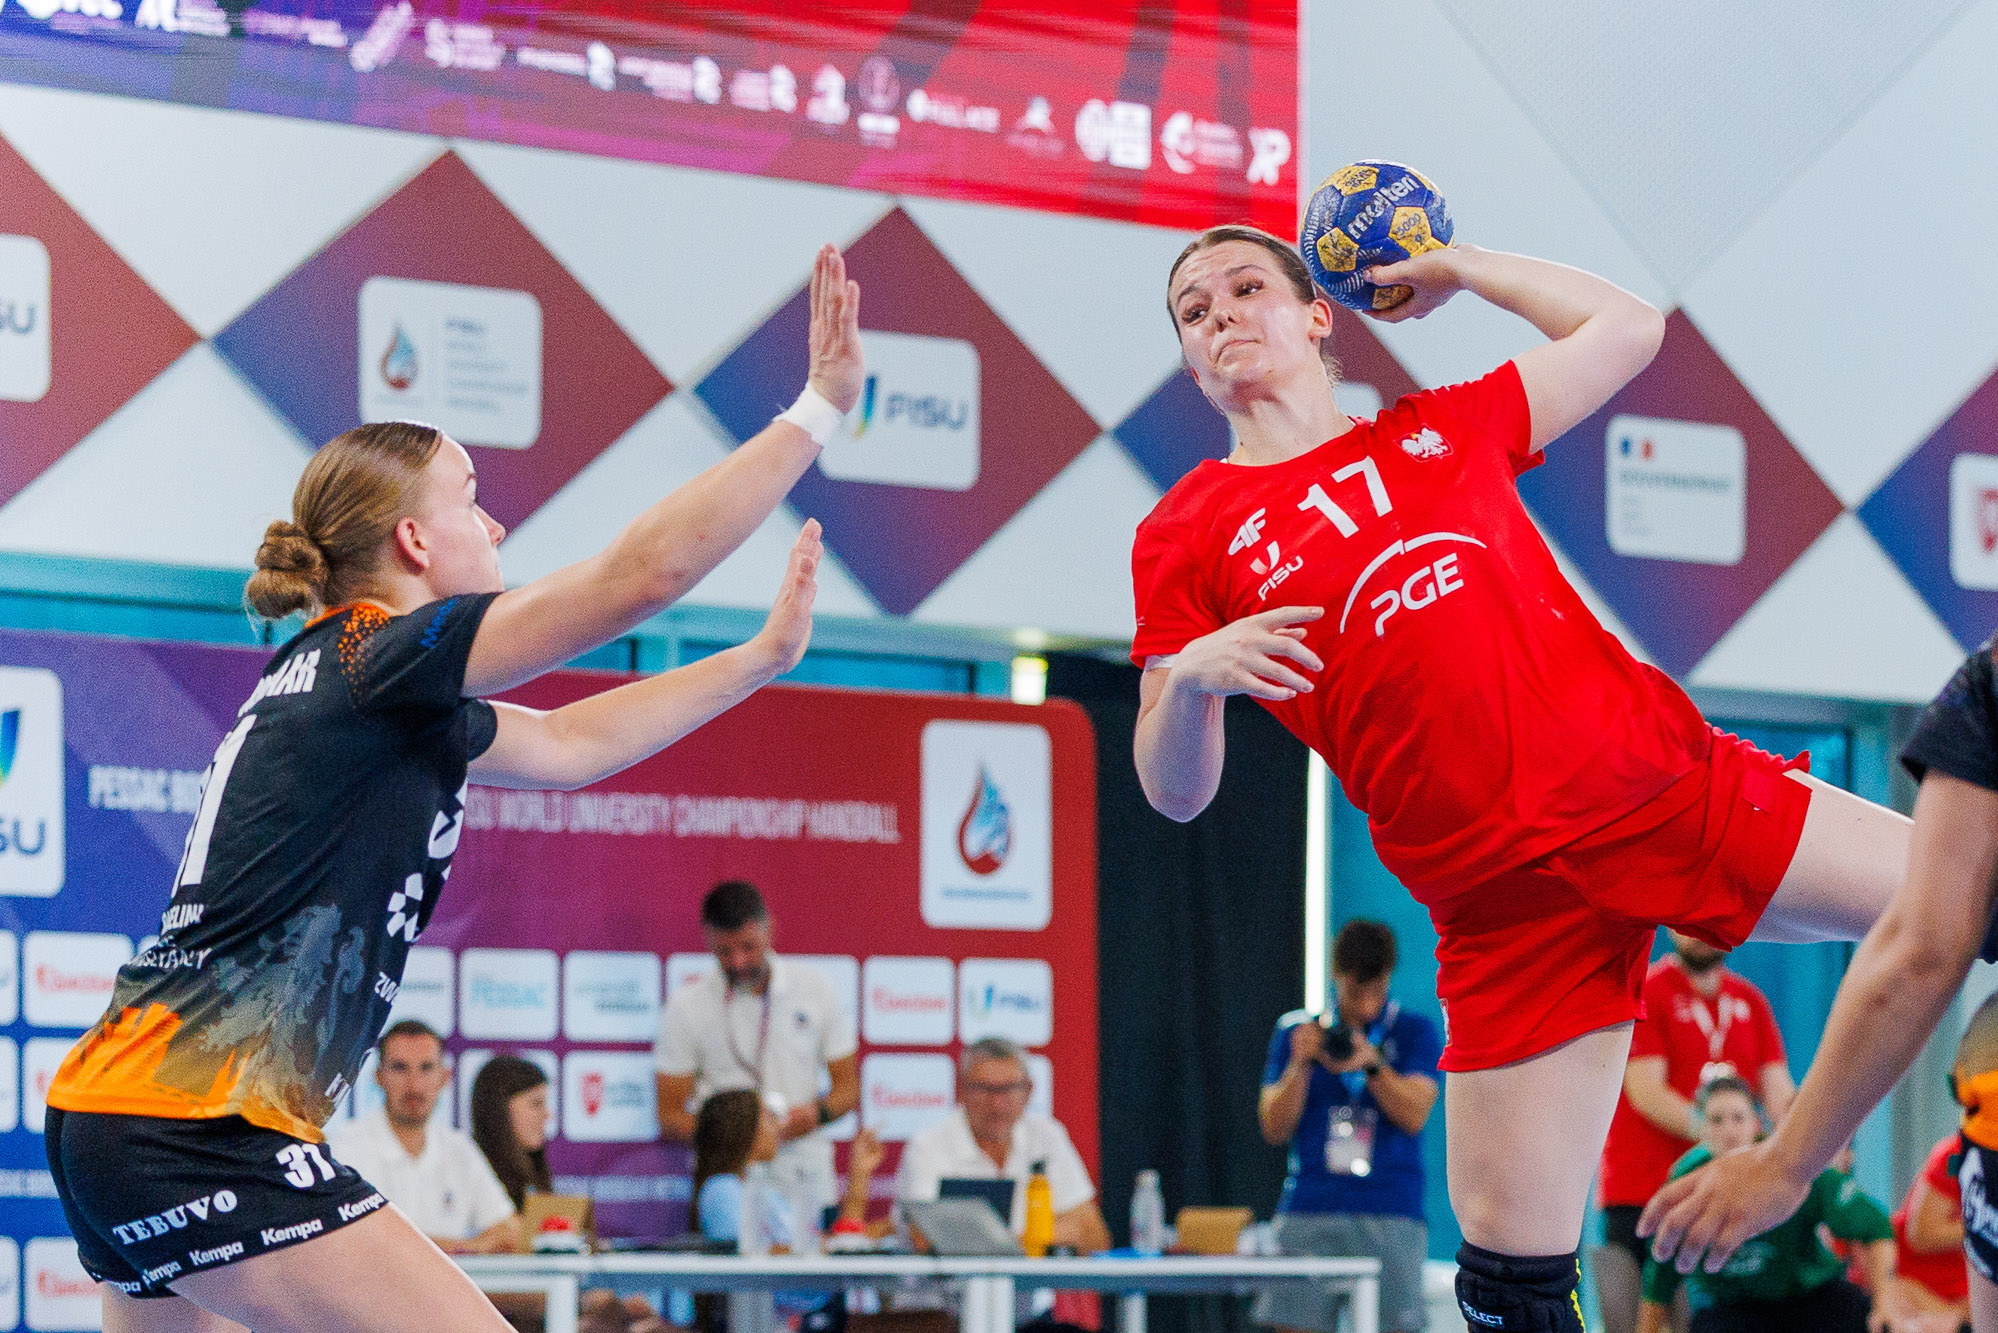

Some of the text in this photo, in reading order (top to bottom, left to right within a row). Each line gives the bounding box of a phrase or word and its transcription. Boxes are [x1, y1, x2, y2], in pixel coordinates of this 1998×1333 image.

[1347, 174, 1420, 240] molten
[1297, 455, 1394, 539] 17
[1257, 555, 1304, 602] FISU
[1370, 552, 1465, 637] PGE
[275, 1142, 337, 1190] 31
[112, 1189, 238, 1245] TEBUVO
[260, 1218, 324, 1246] Kempa
[188, 1240, 245, 1266] Kempa
[1462, 1300, 1504, 1326] SELECT
